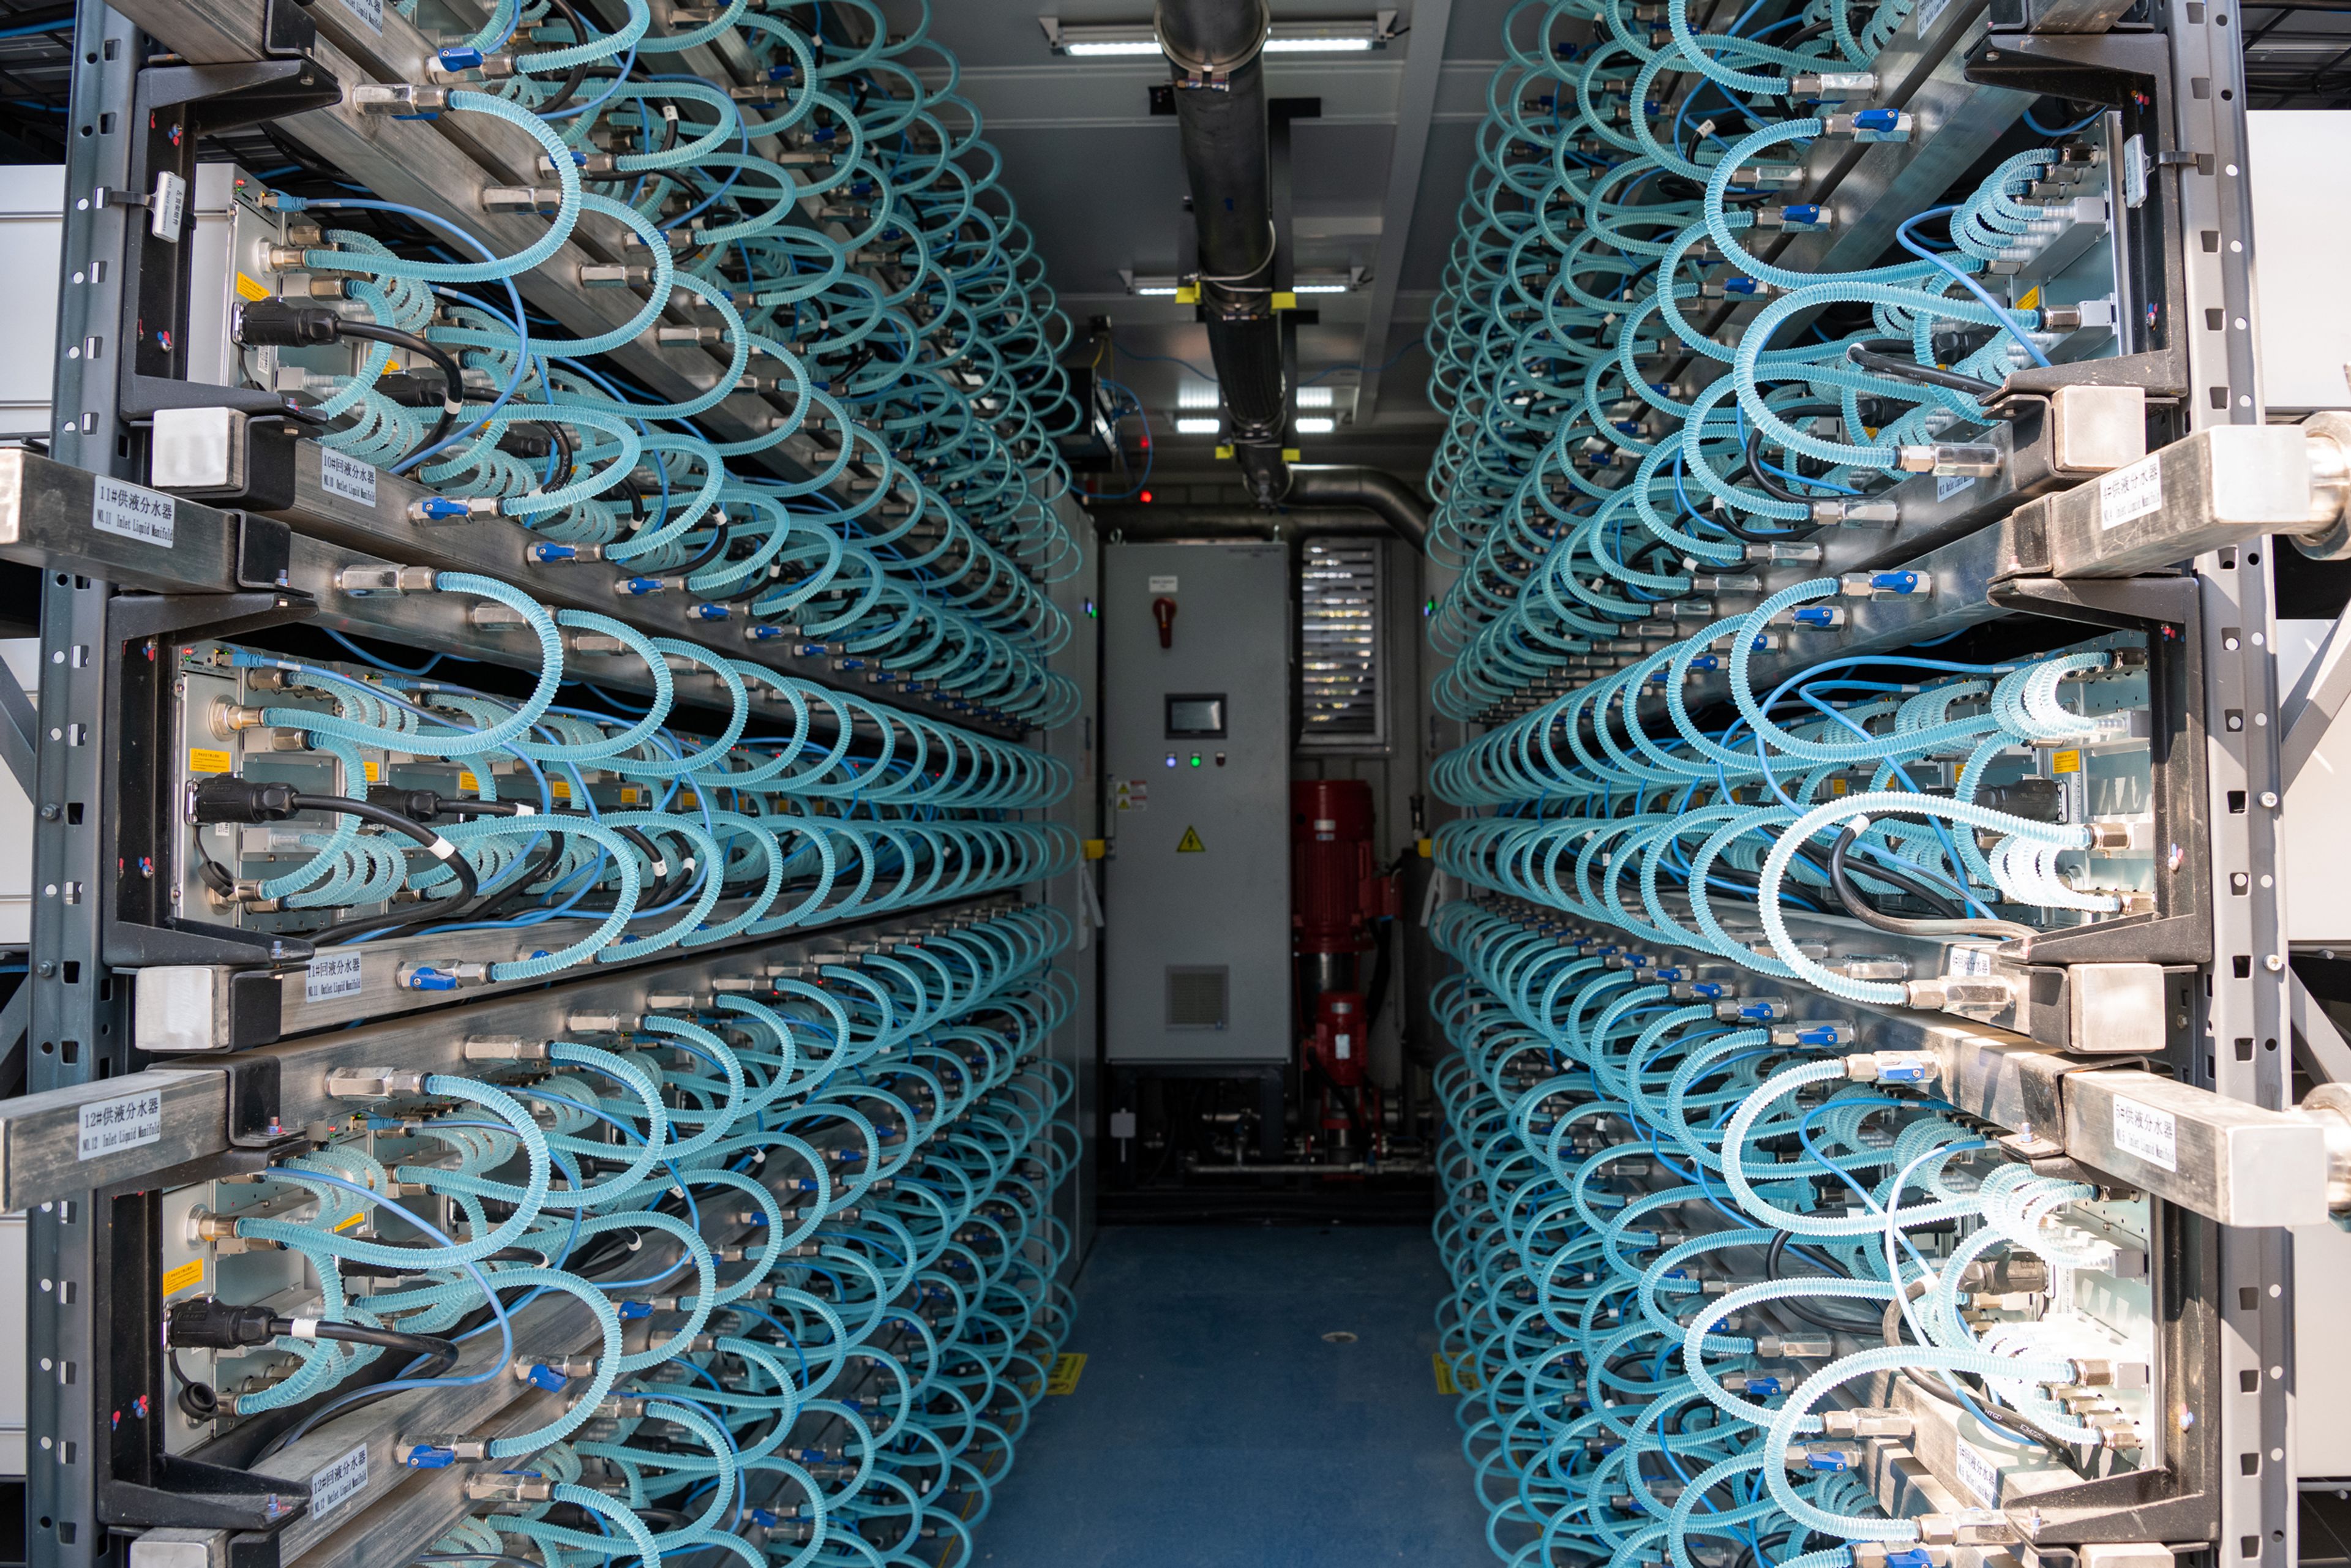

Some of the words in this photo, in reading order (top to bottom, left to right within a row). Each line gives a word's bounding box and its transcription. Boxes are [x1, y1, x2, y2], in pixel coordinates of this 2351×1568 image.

[324, 455, 375, 485] 10#回液分水器
[100, 486, 172, 520] 11#供液分水器
[348, 482, 360, 497] Liquid
[361, 487, 375, 502] Manifold
[116, 514, 131, 530] Inlet
[132, 519, 150, 535] Liquid
[151, 523, 173, 542] Manifold
[308, 958, 360, 978] 11#回液分水器
[334, 980, 345, 994] Liquid
[346, 978, 360, 991] Manifold
[85, 1097, 158, 1128] 12#供液分水器
[103, 1132, 117, 1147] Inlet
[119, 1127, 136, 1144] Liquid
[138, 1121, 160, 1138] Manifold
[1984, 1409, 2002, 1420] HTGD
[314, 1449, 366, 1495] 12#回液分水器
[339, 1479, 351, 1496] Liquid
[352, 1469, 367, 1488] Manifold
